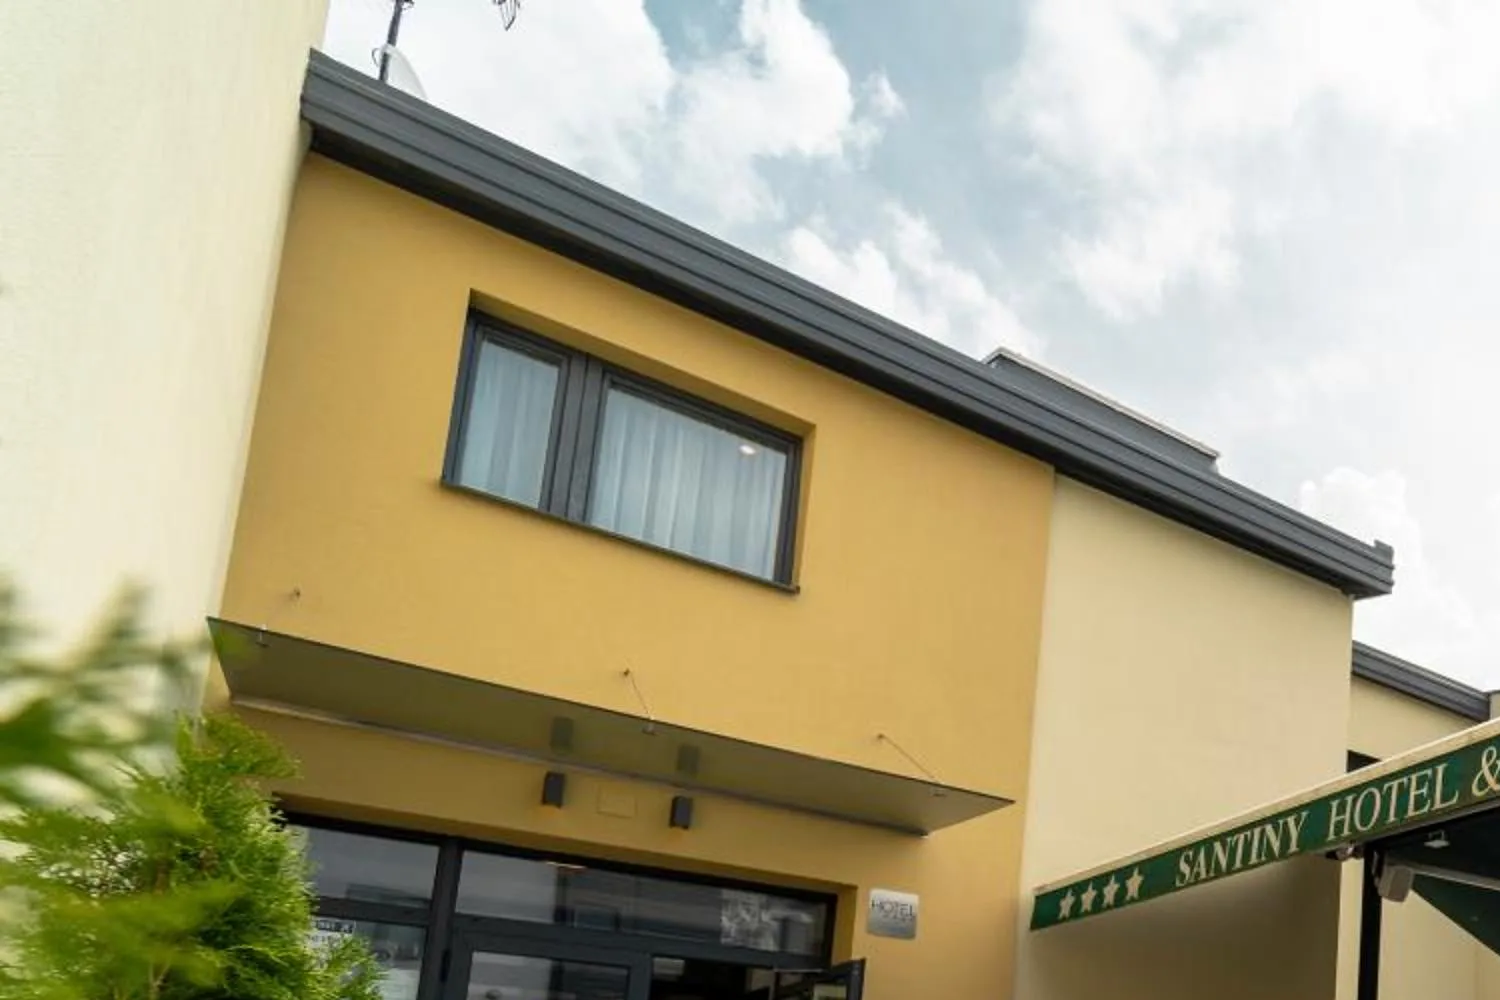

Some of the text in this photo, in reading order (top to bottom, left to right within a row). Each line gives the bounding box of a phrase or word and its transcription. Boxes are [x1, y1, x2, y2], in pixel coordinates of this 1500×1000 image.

[1175, 811, 1309, 887] SANTINY
[1327, 763, 1459, 841] HOTEL
[871, 898, 916, 917] HOTEL
